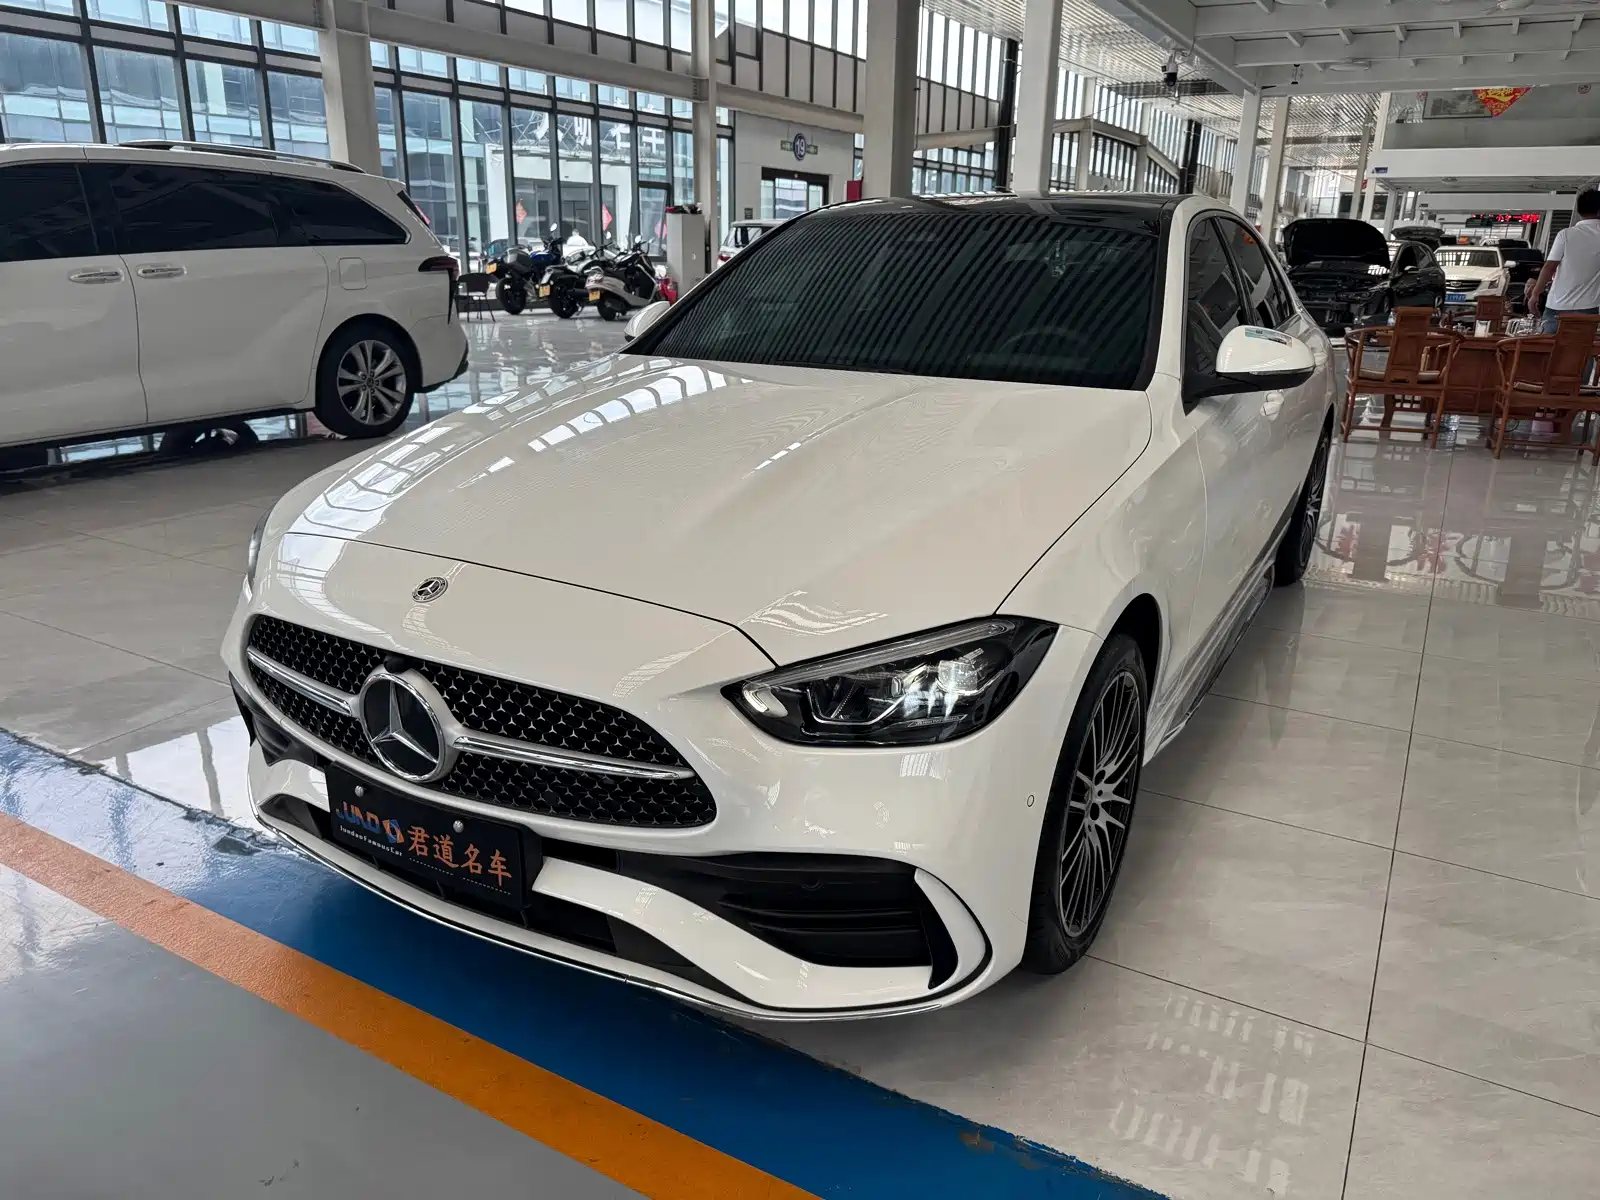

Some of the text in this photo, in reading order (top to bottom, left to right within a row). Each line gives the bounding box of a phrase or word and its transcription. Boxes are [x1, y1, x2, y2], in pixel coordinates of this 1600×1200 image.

[795, 138, 805, 156] 19
[407, 825, 512, 887] 君道名车
